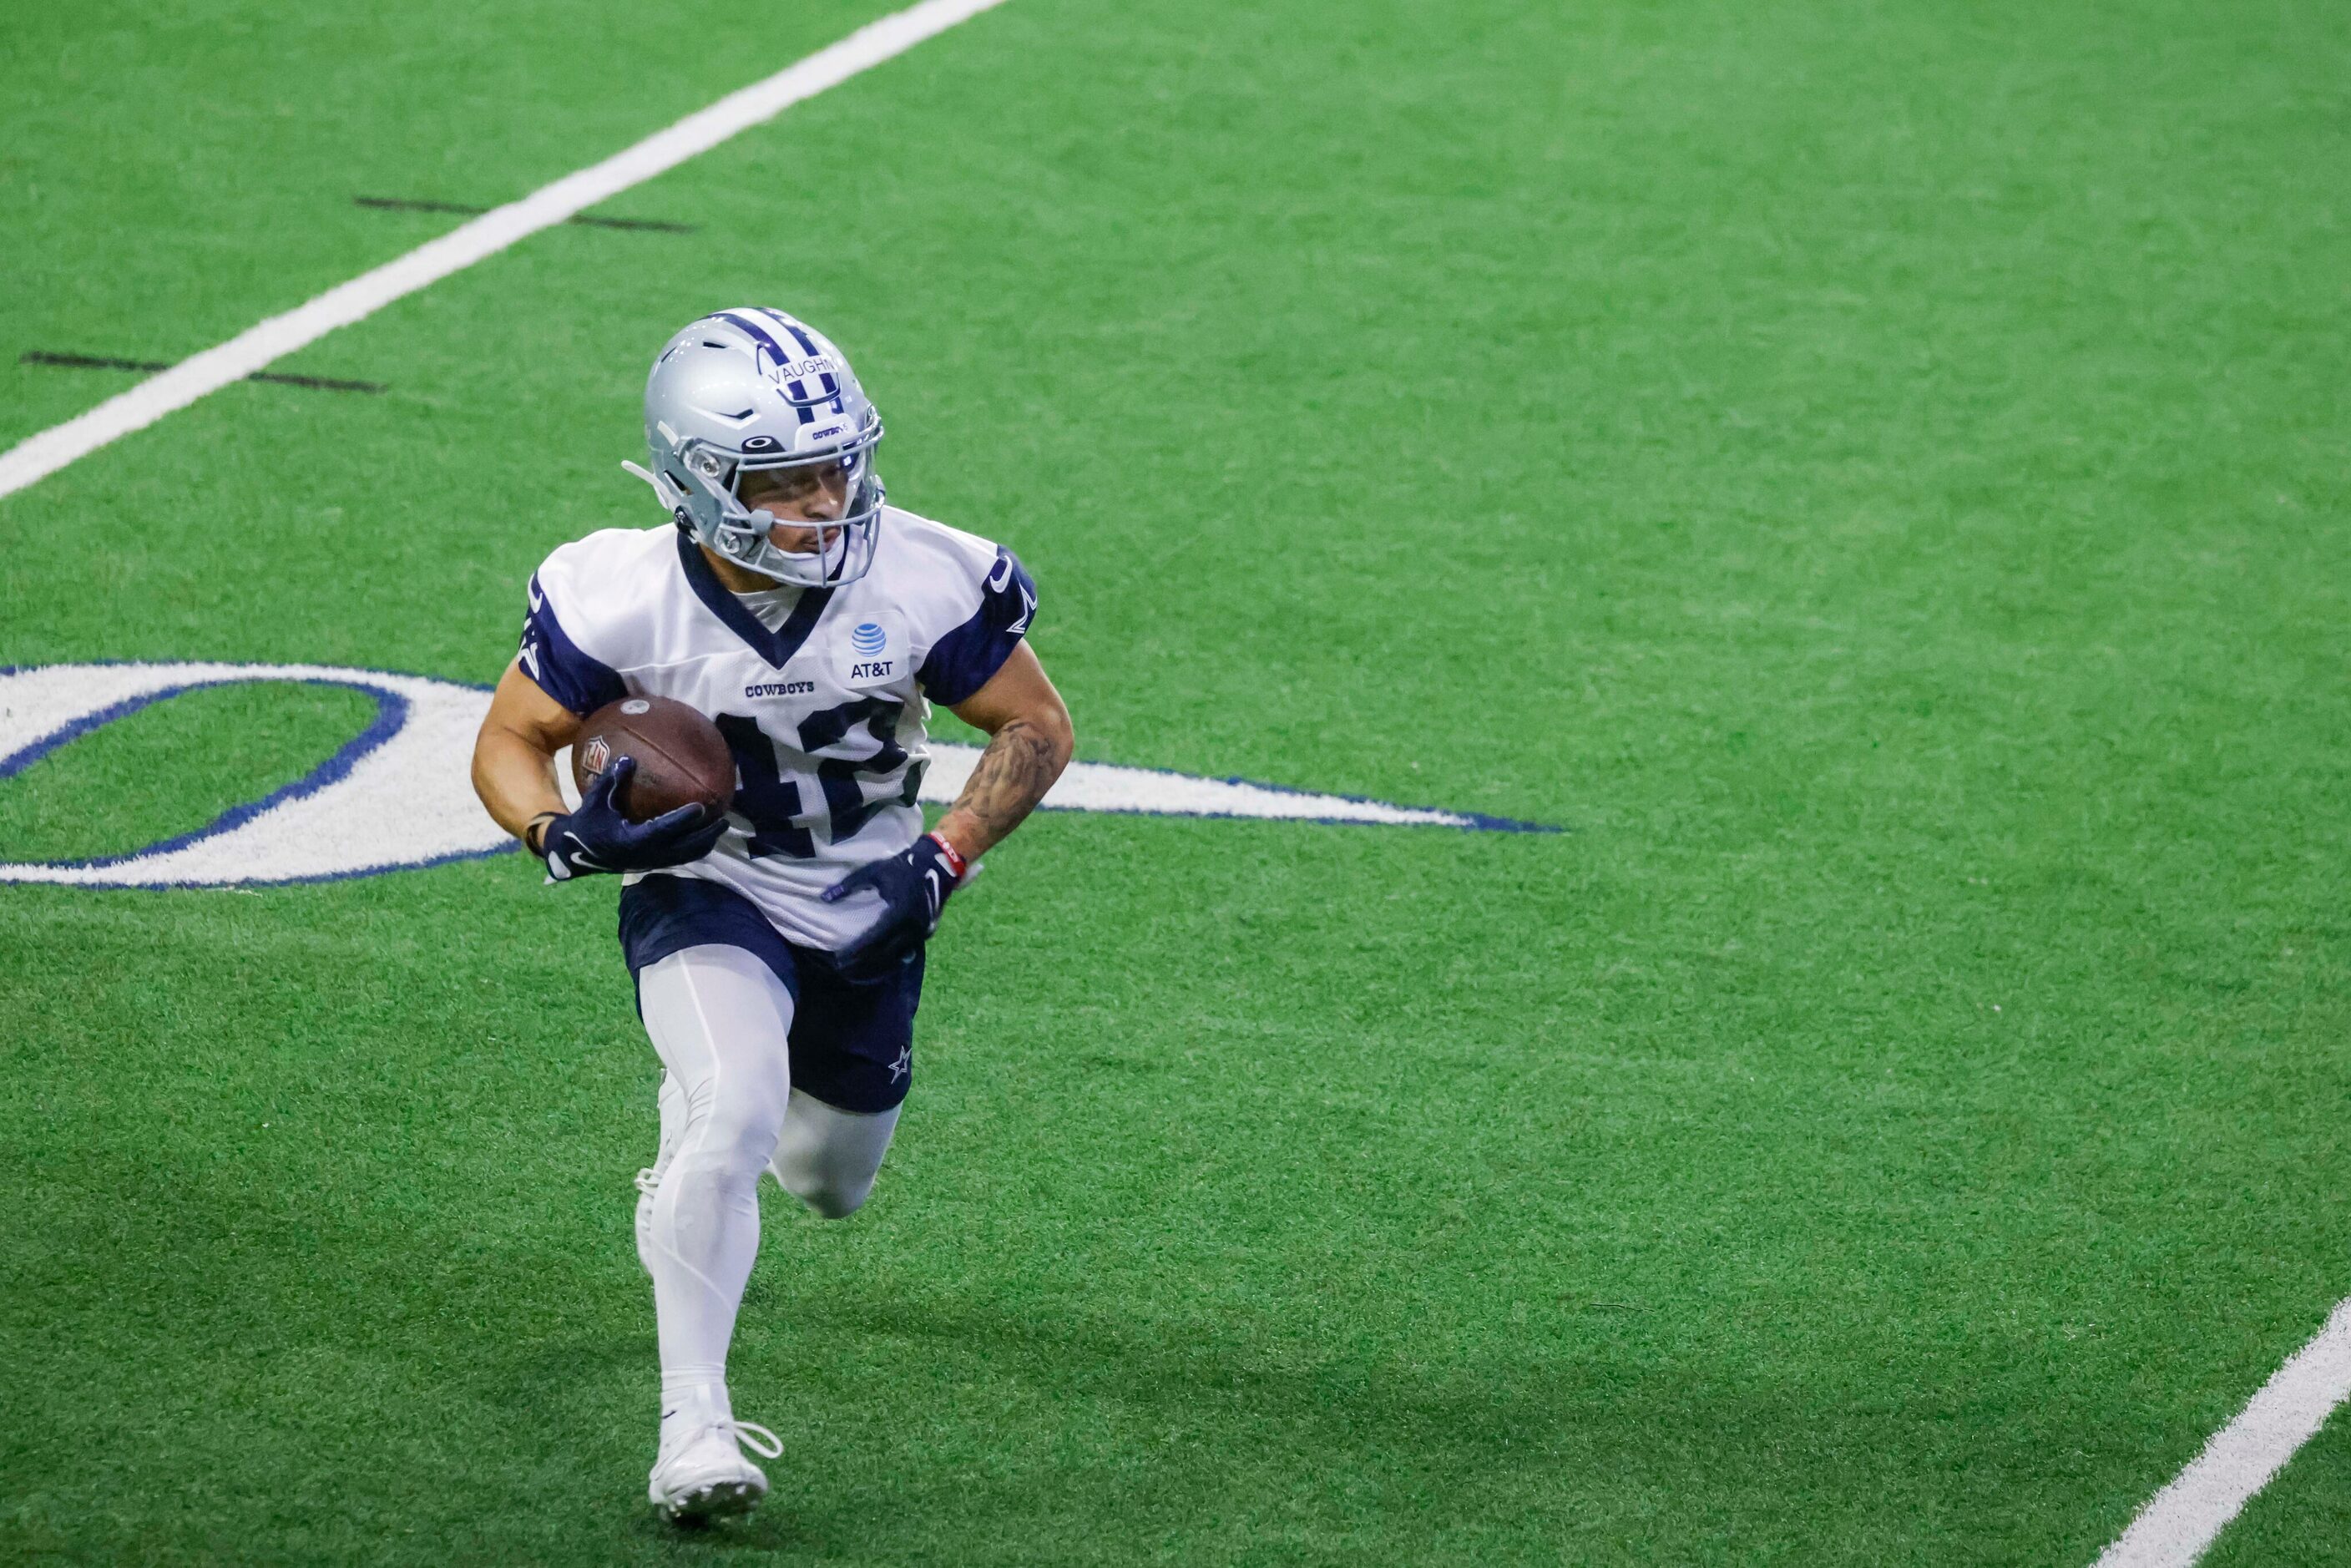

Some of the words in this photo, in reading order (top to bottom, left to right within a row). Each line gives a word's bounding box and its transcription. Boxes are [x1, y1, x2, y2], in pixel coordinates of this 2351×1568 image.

[768, 357, 836, 384] VAUGHN
[851, 661, 892, 679] AT&T
[745, 680, 815, 698] COWBOYS
[715, 695, 924, 860] 42
